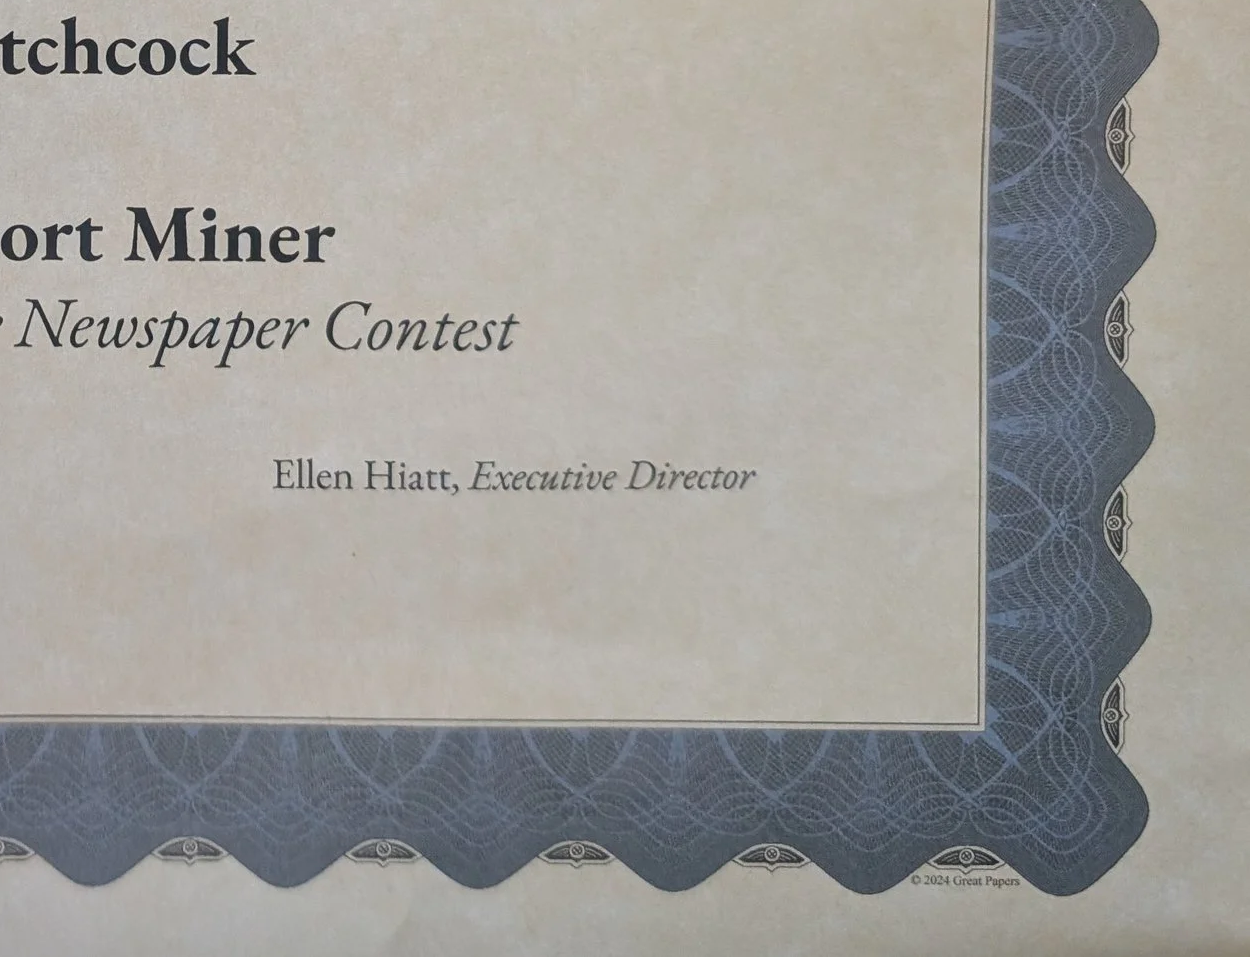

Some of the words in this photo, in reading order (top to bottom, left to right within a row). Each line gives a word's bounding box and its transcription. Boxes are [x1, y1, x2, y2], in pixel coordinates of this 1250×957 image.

[124, 207, 335, 263] Miner
[14, 299, 310, 368] Newspaper
[326, 301, 520, 351] Contest
[273, 458, 353, 490] Ellen
[365, 461, 459, 496] Hiatt,
[467, 461, 617, 491] Executive
[625, 461, 757, 490] Director
[924, 875, 950, 885] 2024
[953, 875, 982, 886] Great
[985, 875, 1020, 889] Papers
